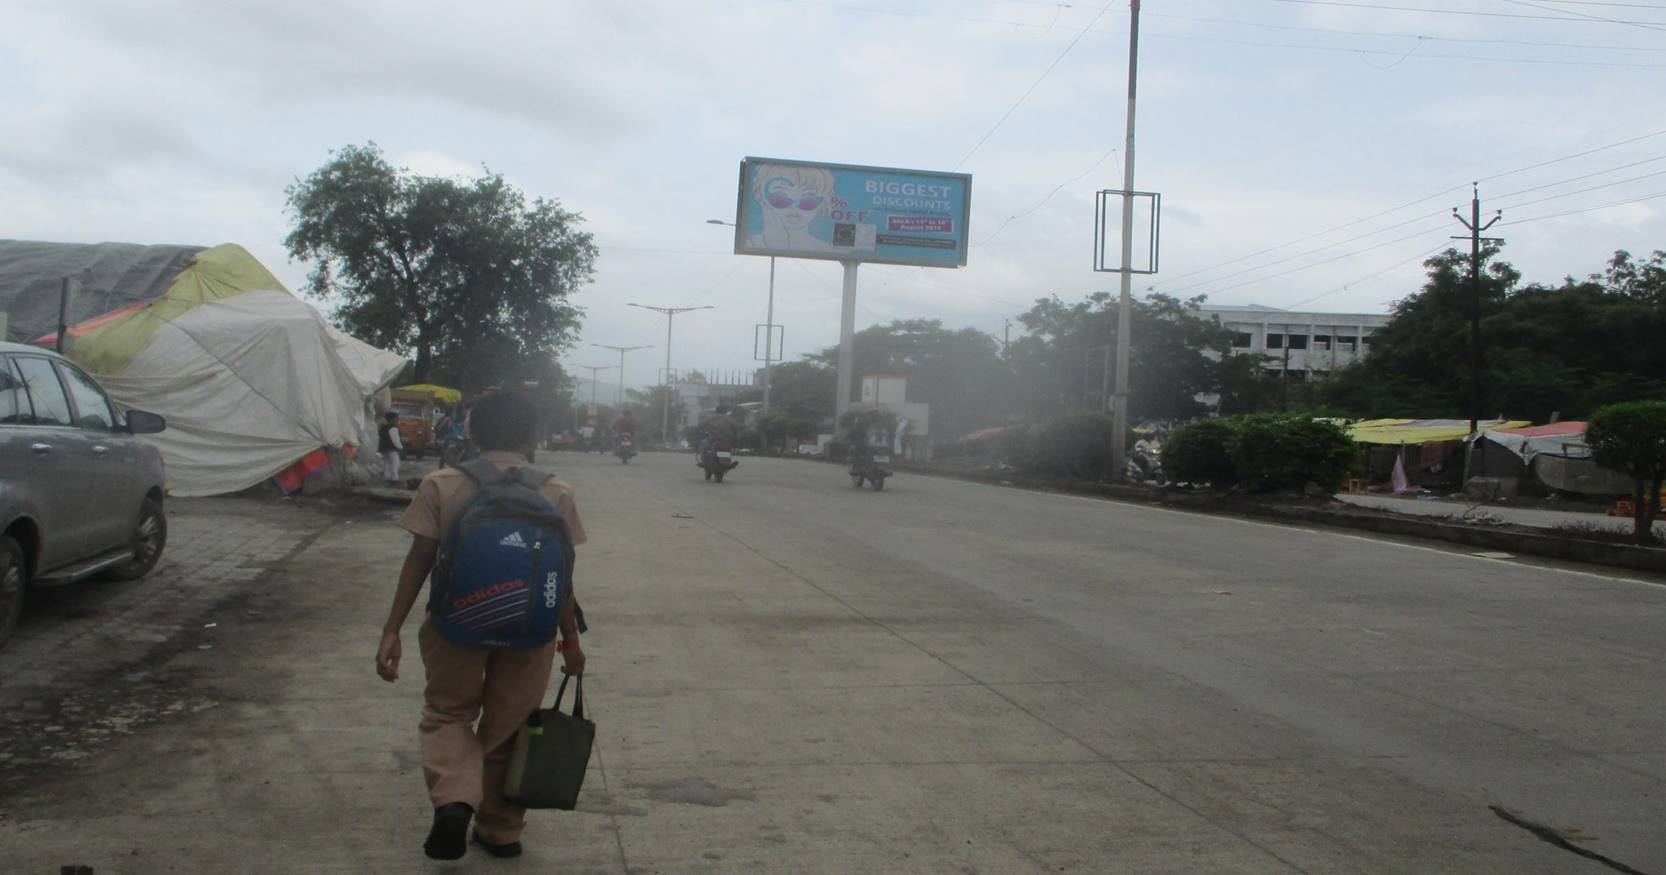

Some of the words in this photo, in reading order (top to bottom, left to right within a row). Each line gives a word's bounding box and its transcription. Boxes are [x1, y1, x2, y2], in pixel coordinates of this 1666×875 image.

[865, 180, 952, 198] BIGGEST
[873, 196, 951, 210] DISCOUNTS
[831, 209, 866, 221] OFF
[454, 578, 525, 608] adidas
